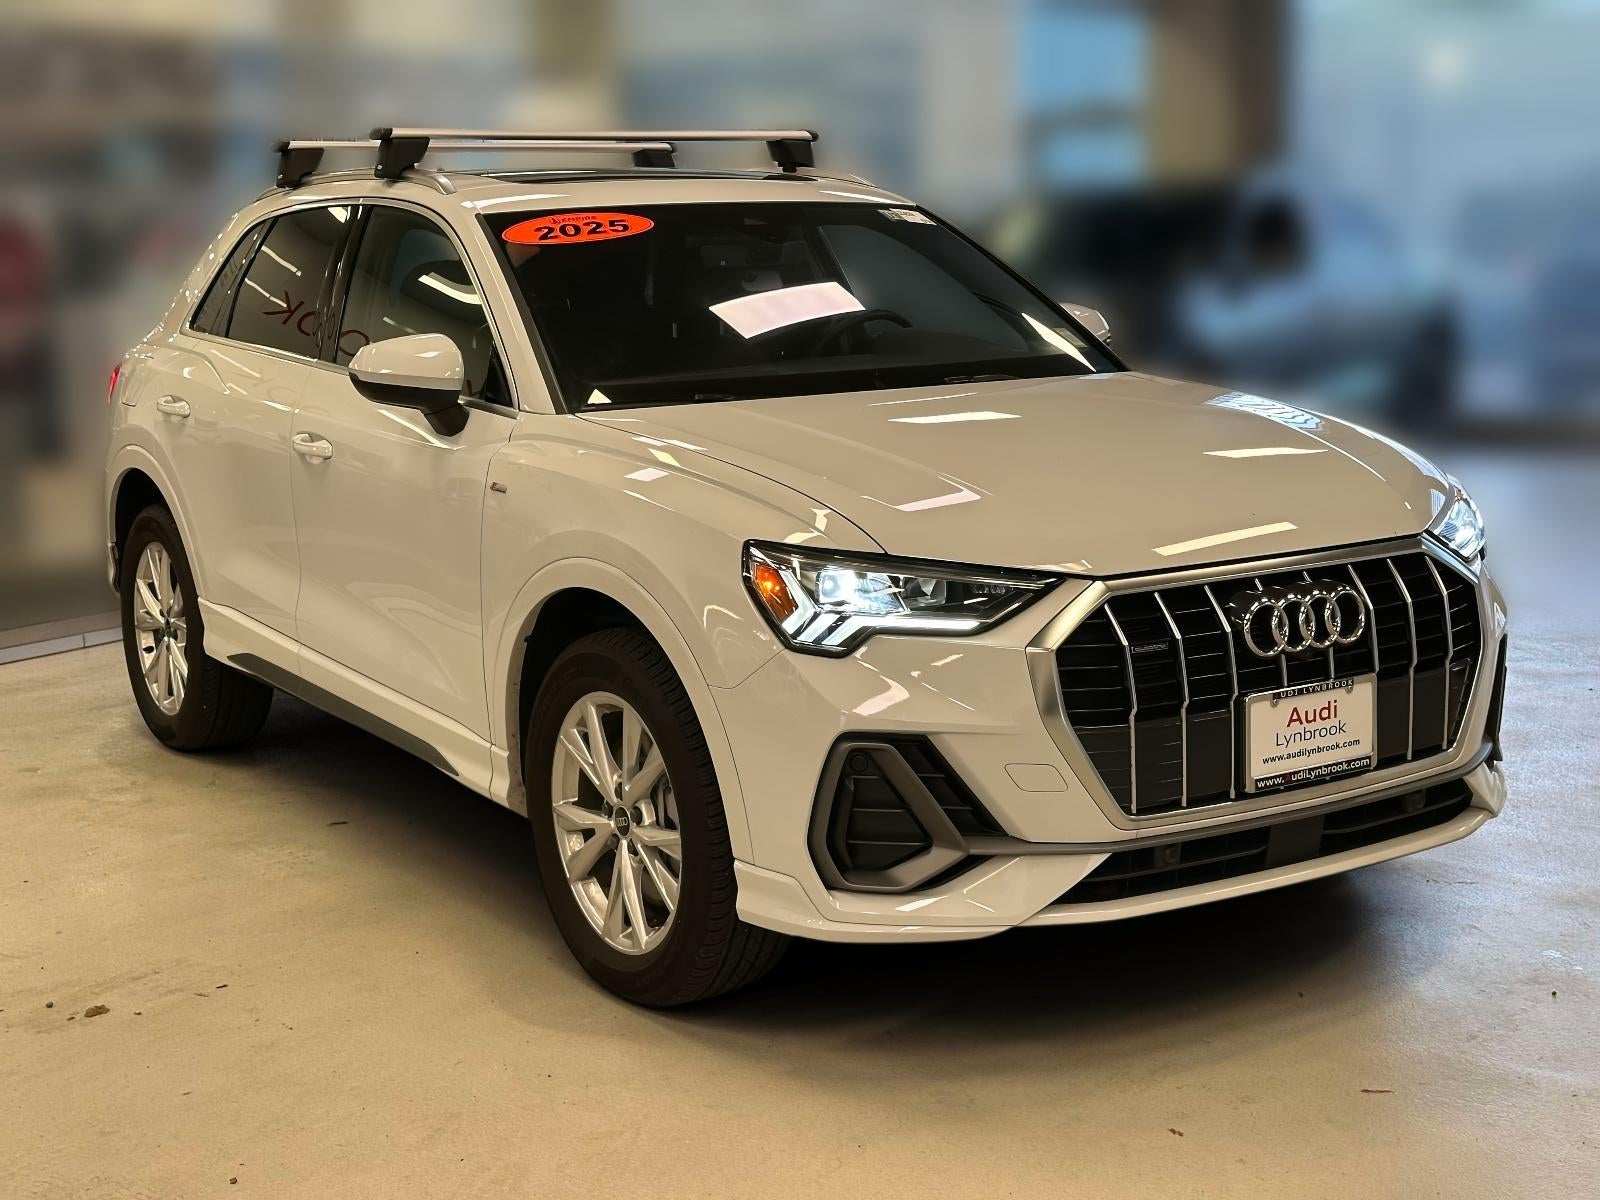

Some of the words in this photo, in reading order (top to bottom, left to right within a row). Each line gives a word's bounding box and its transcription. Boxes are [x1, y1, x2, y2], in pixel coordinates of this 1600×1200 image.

[534, 219, 630, 241] 2025
[1303, 679, 1353, 694] LYNBROOK
[1286, 700, 1338, 727] Audi
[1275, 720, 1347, 748] Lynbrook
[1262, 738, 1361, 765] www.audilynbrook.com
